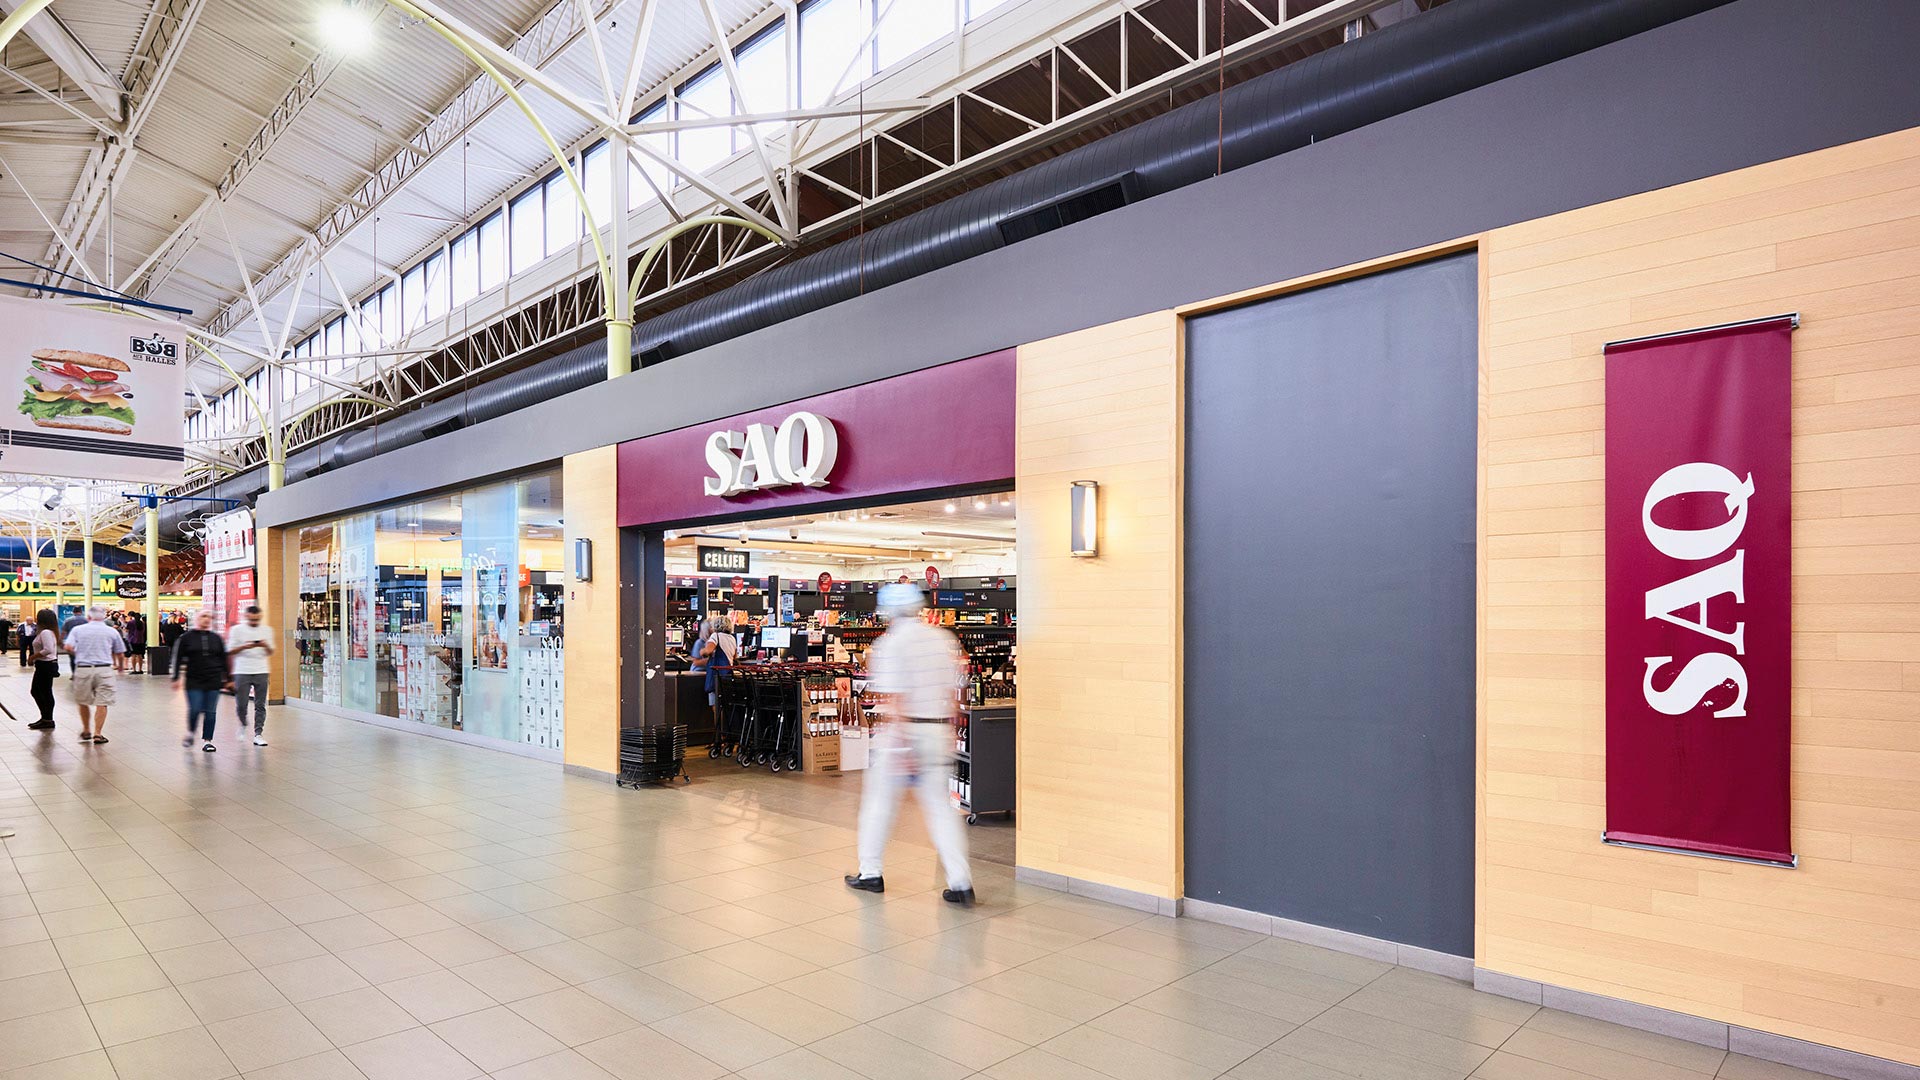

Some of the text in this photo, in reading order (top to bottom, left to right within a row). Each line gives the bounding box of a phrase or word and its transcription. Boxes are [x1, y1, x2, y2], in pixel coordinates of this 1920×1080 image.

[132, 338, 176, 358] BOB
[145, 355, 176, 365] HALLES
[703, 411, 839, 497] SAQ
[704, 553, 746, 569] CELLIER
[1642, 462, 1755, 719] SAQ
[541, 635, 563, 650] SAQ
